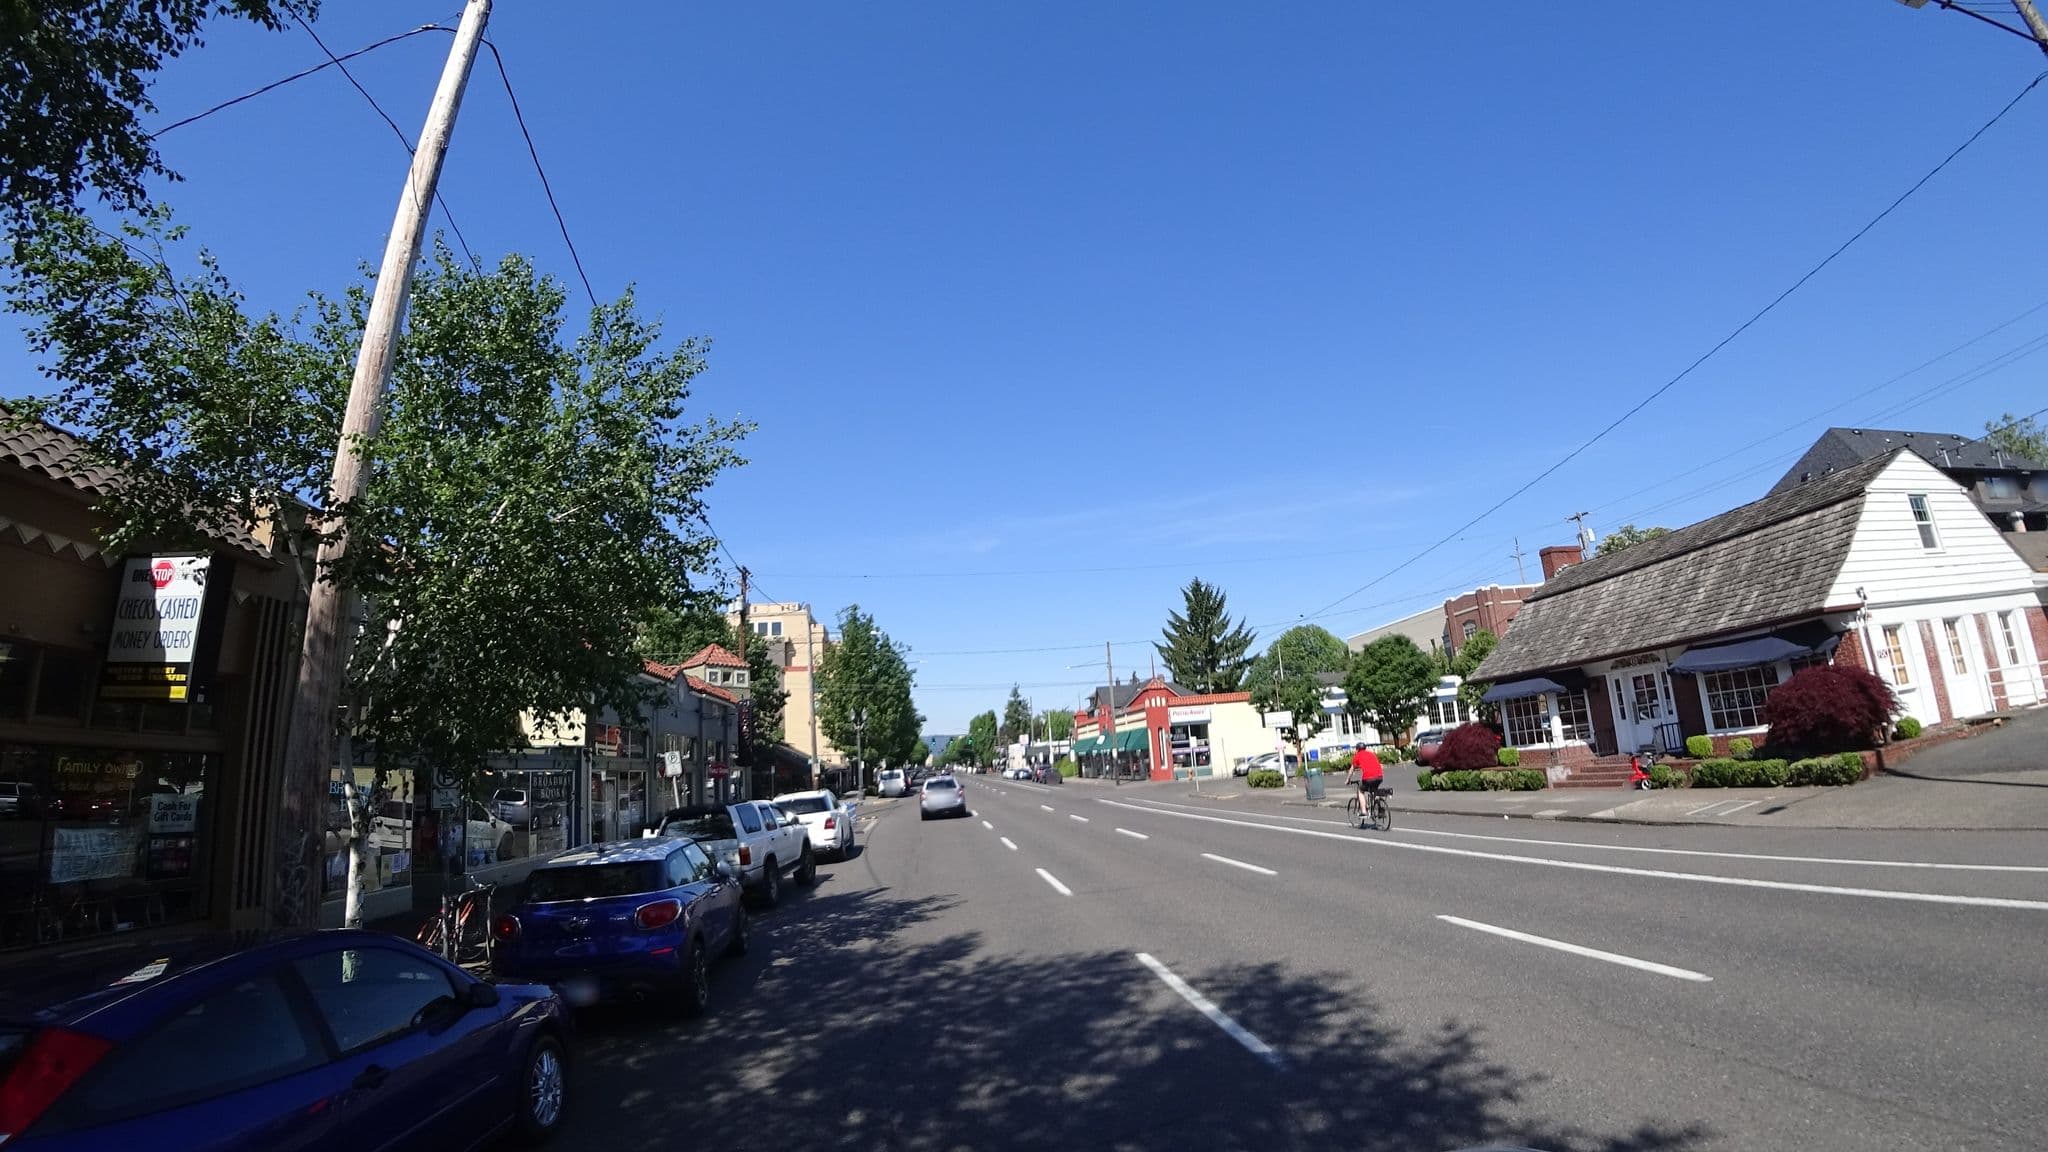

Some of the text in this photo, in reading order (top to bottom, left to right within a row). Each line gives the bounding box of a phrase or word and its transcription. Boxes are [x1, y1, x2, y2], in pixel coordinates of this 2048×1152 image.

[132, 569, 150, 582] ONE
[153, 568, 173, 581] STOP
[119, 598, 198, 620] CHECKS CASHED
[113, 630, 192, 649] MONEY ORDERS
[158, 801, 191, 811] Cash For
[155, 811, 192, 822] Gift Cards
